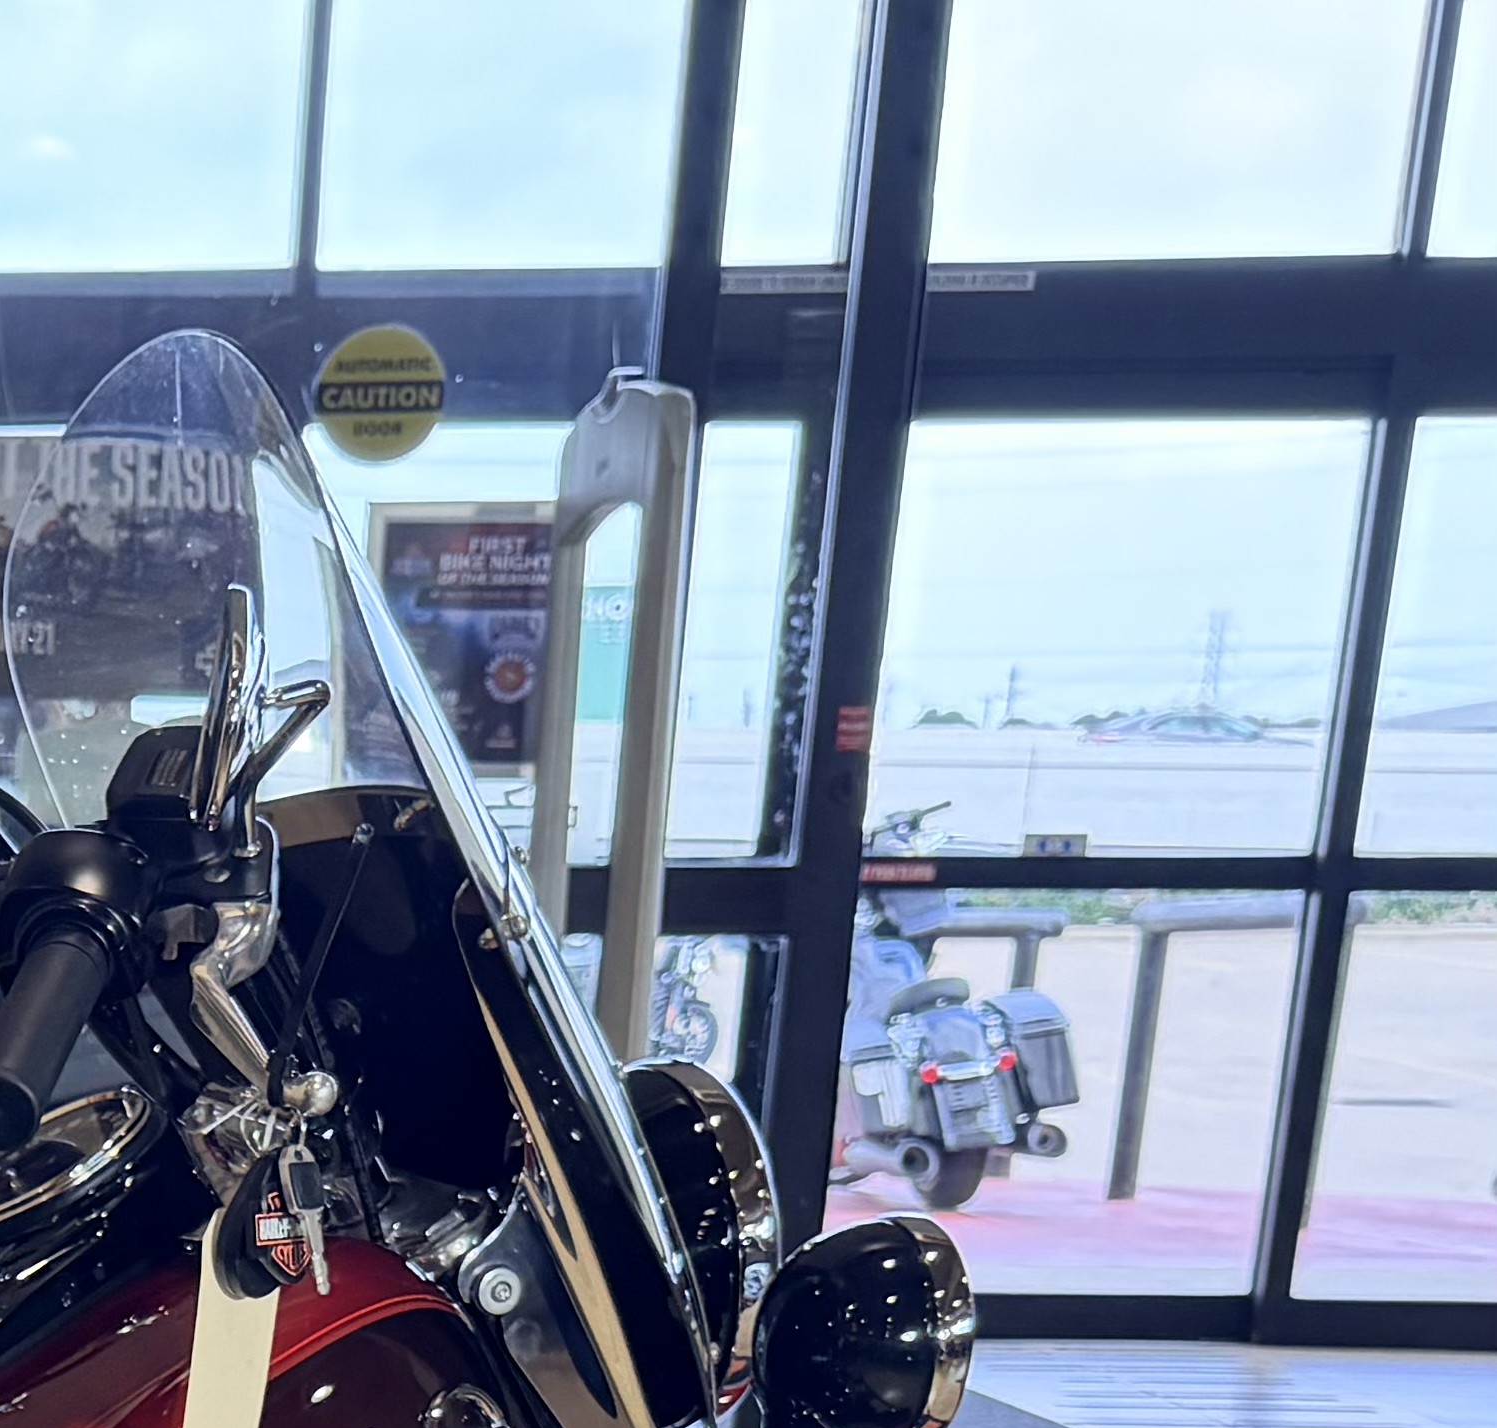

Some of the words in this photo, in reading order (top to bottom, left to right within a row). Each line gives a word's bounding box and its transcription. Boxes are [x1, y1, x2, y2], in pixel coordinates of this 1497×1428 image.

[335, 359, 432, 374] AUTOMATIC
[322, 385, 441, 409] CAUTION
[353, 421, 403, 437] DOOR
[110, 443, 246, 514] SEASON
[468, 536, 527, 553] FIRST
[488, 553, 552, 571] NIGHT
